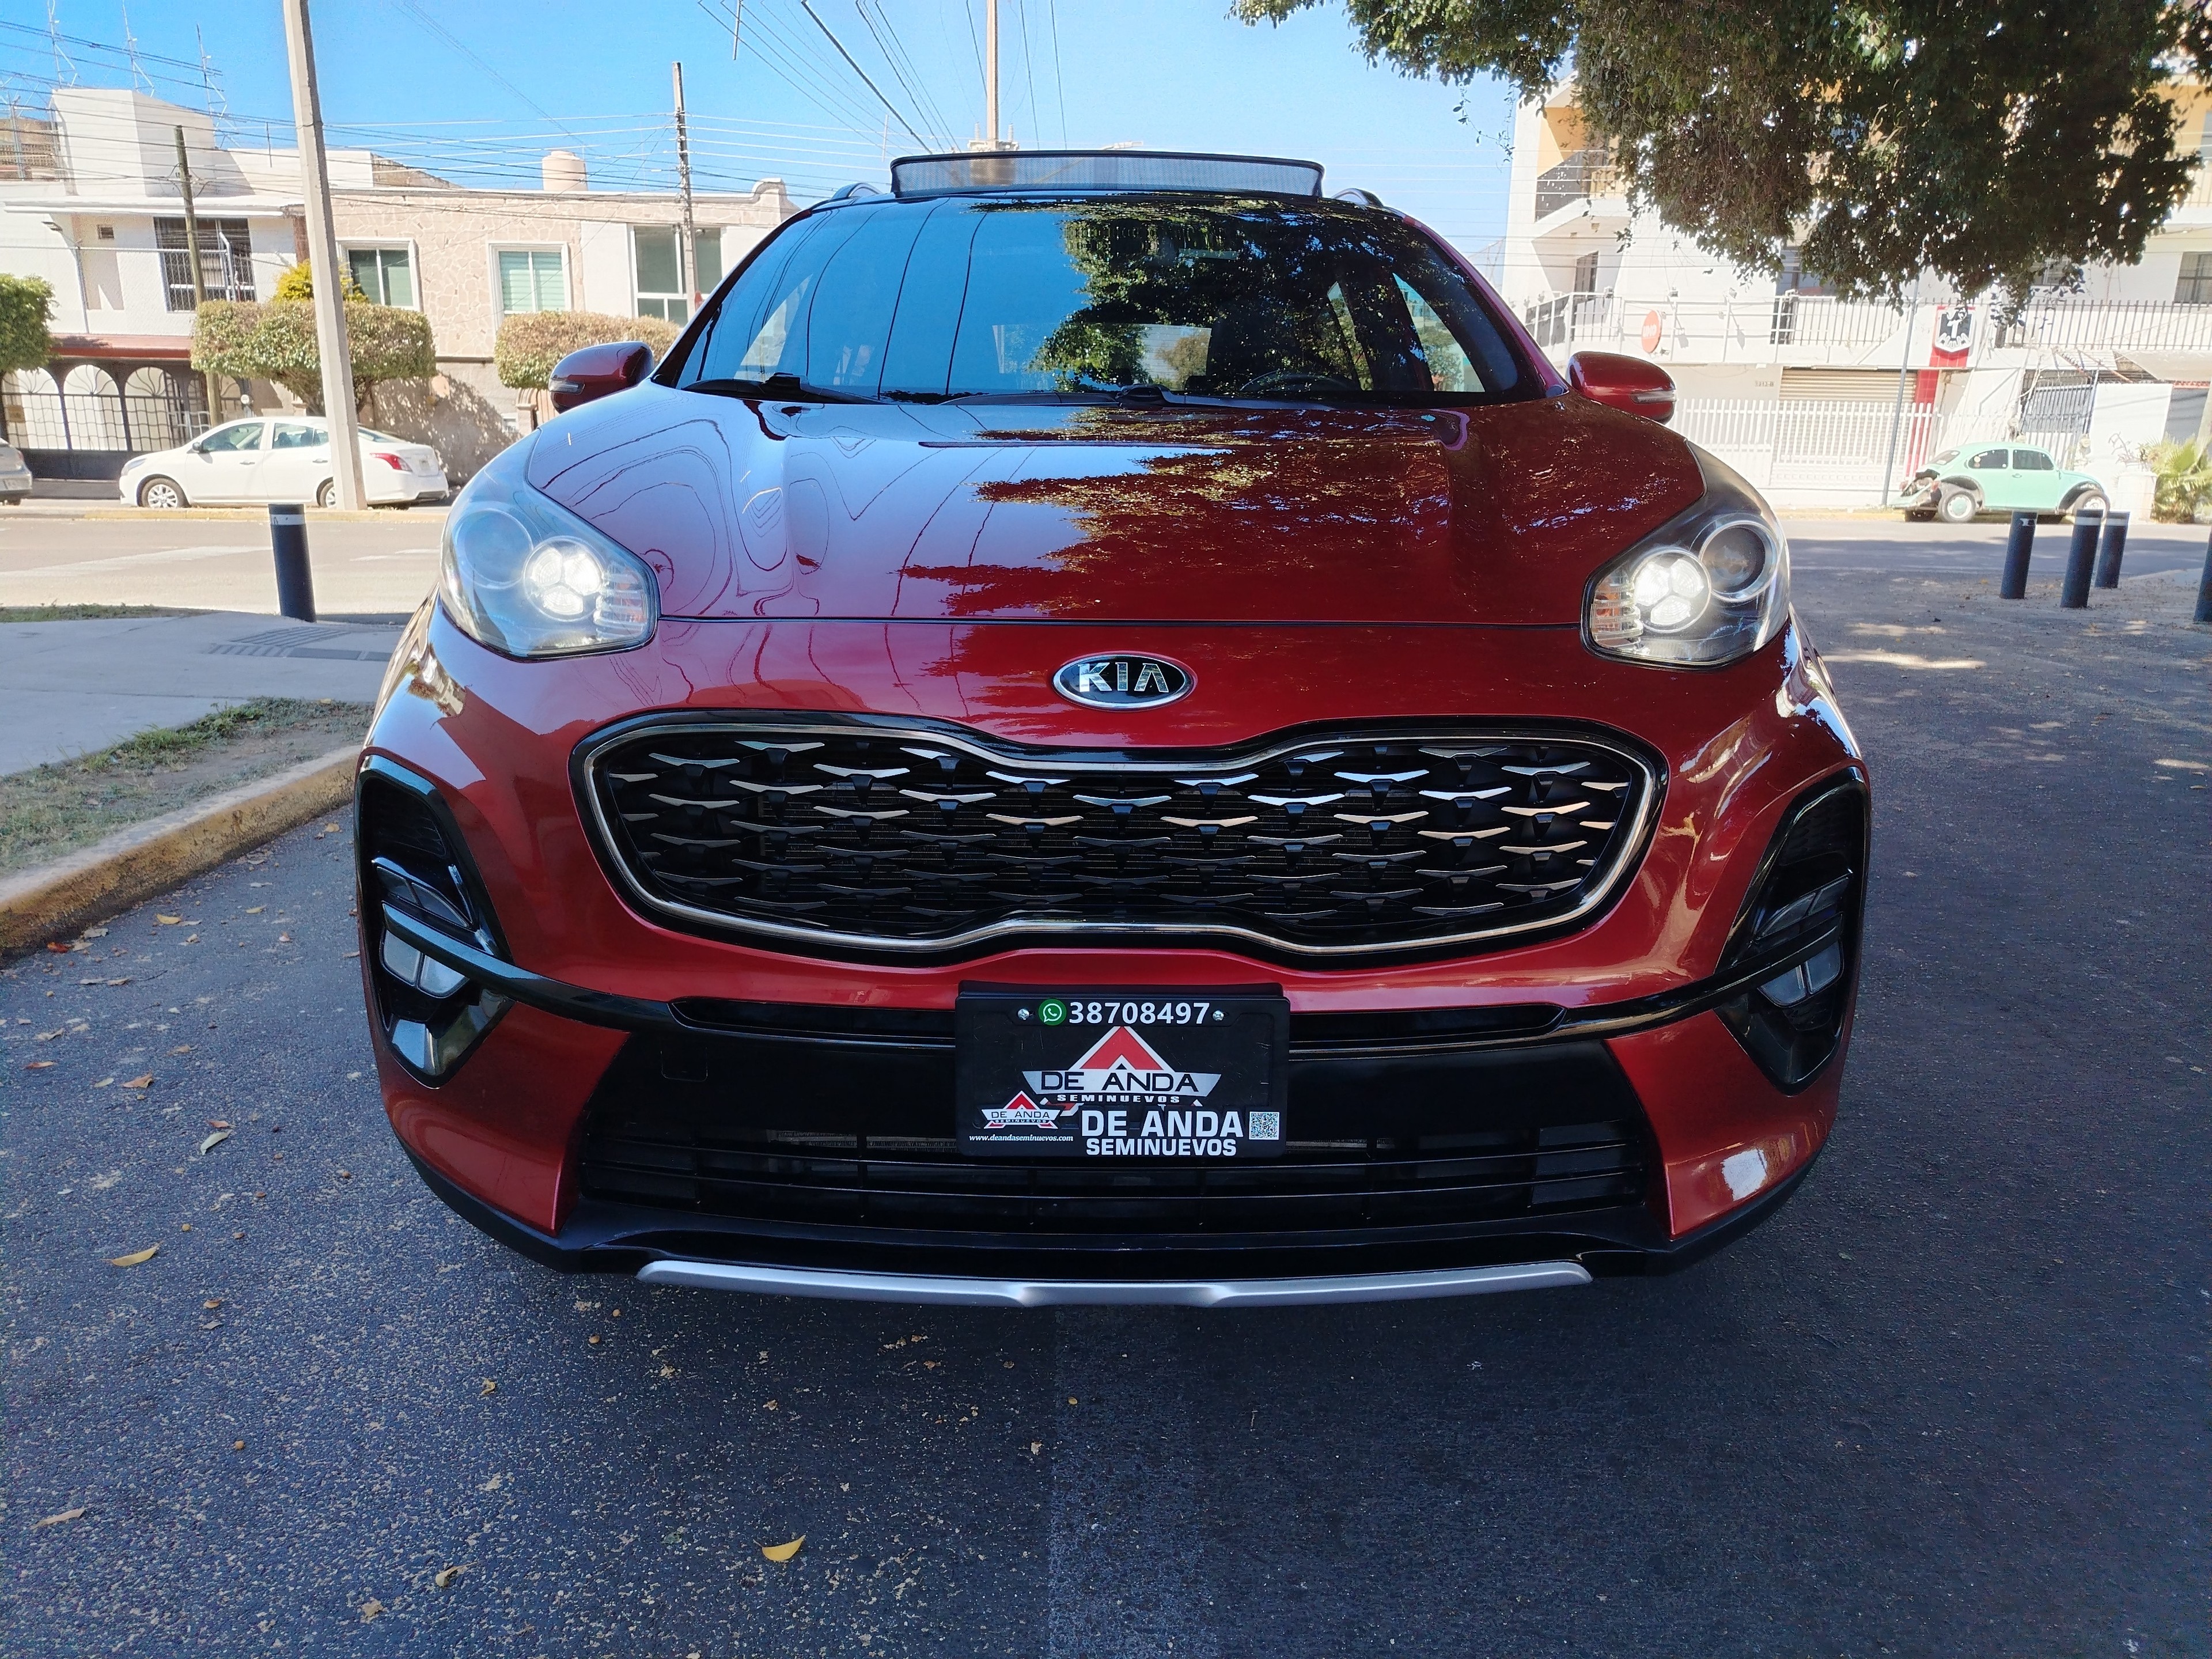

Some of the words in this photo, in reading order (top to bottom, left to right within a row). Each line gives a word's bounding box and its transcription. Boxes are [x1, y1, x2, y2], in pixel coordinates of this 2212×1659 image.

[1078, 662, 1169, 692] KIA
[1069, 1002, 1210, 1025] 38708497
[1041, 1071, 1084, 1090] DE
[1101, 1073, 1199, 1092] ANDA
[1057, 1094, 1180, 1103] SEMINUEVOS
[1082, 1110, 1127, 1137] DE
[1141, 1111, 1243, 1137] ANDA
[969, 1134, 1074, 1142] www.deandaseminuevos.com
[1086, 1138, 1237, 1156] SEMINUEVOS
